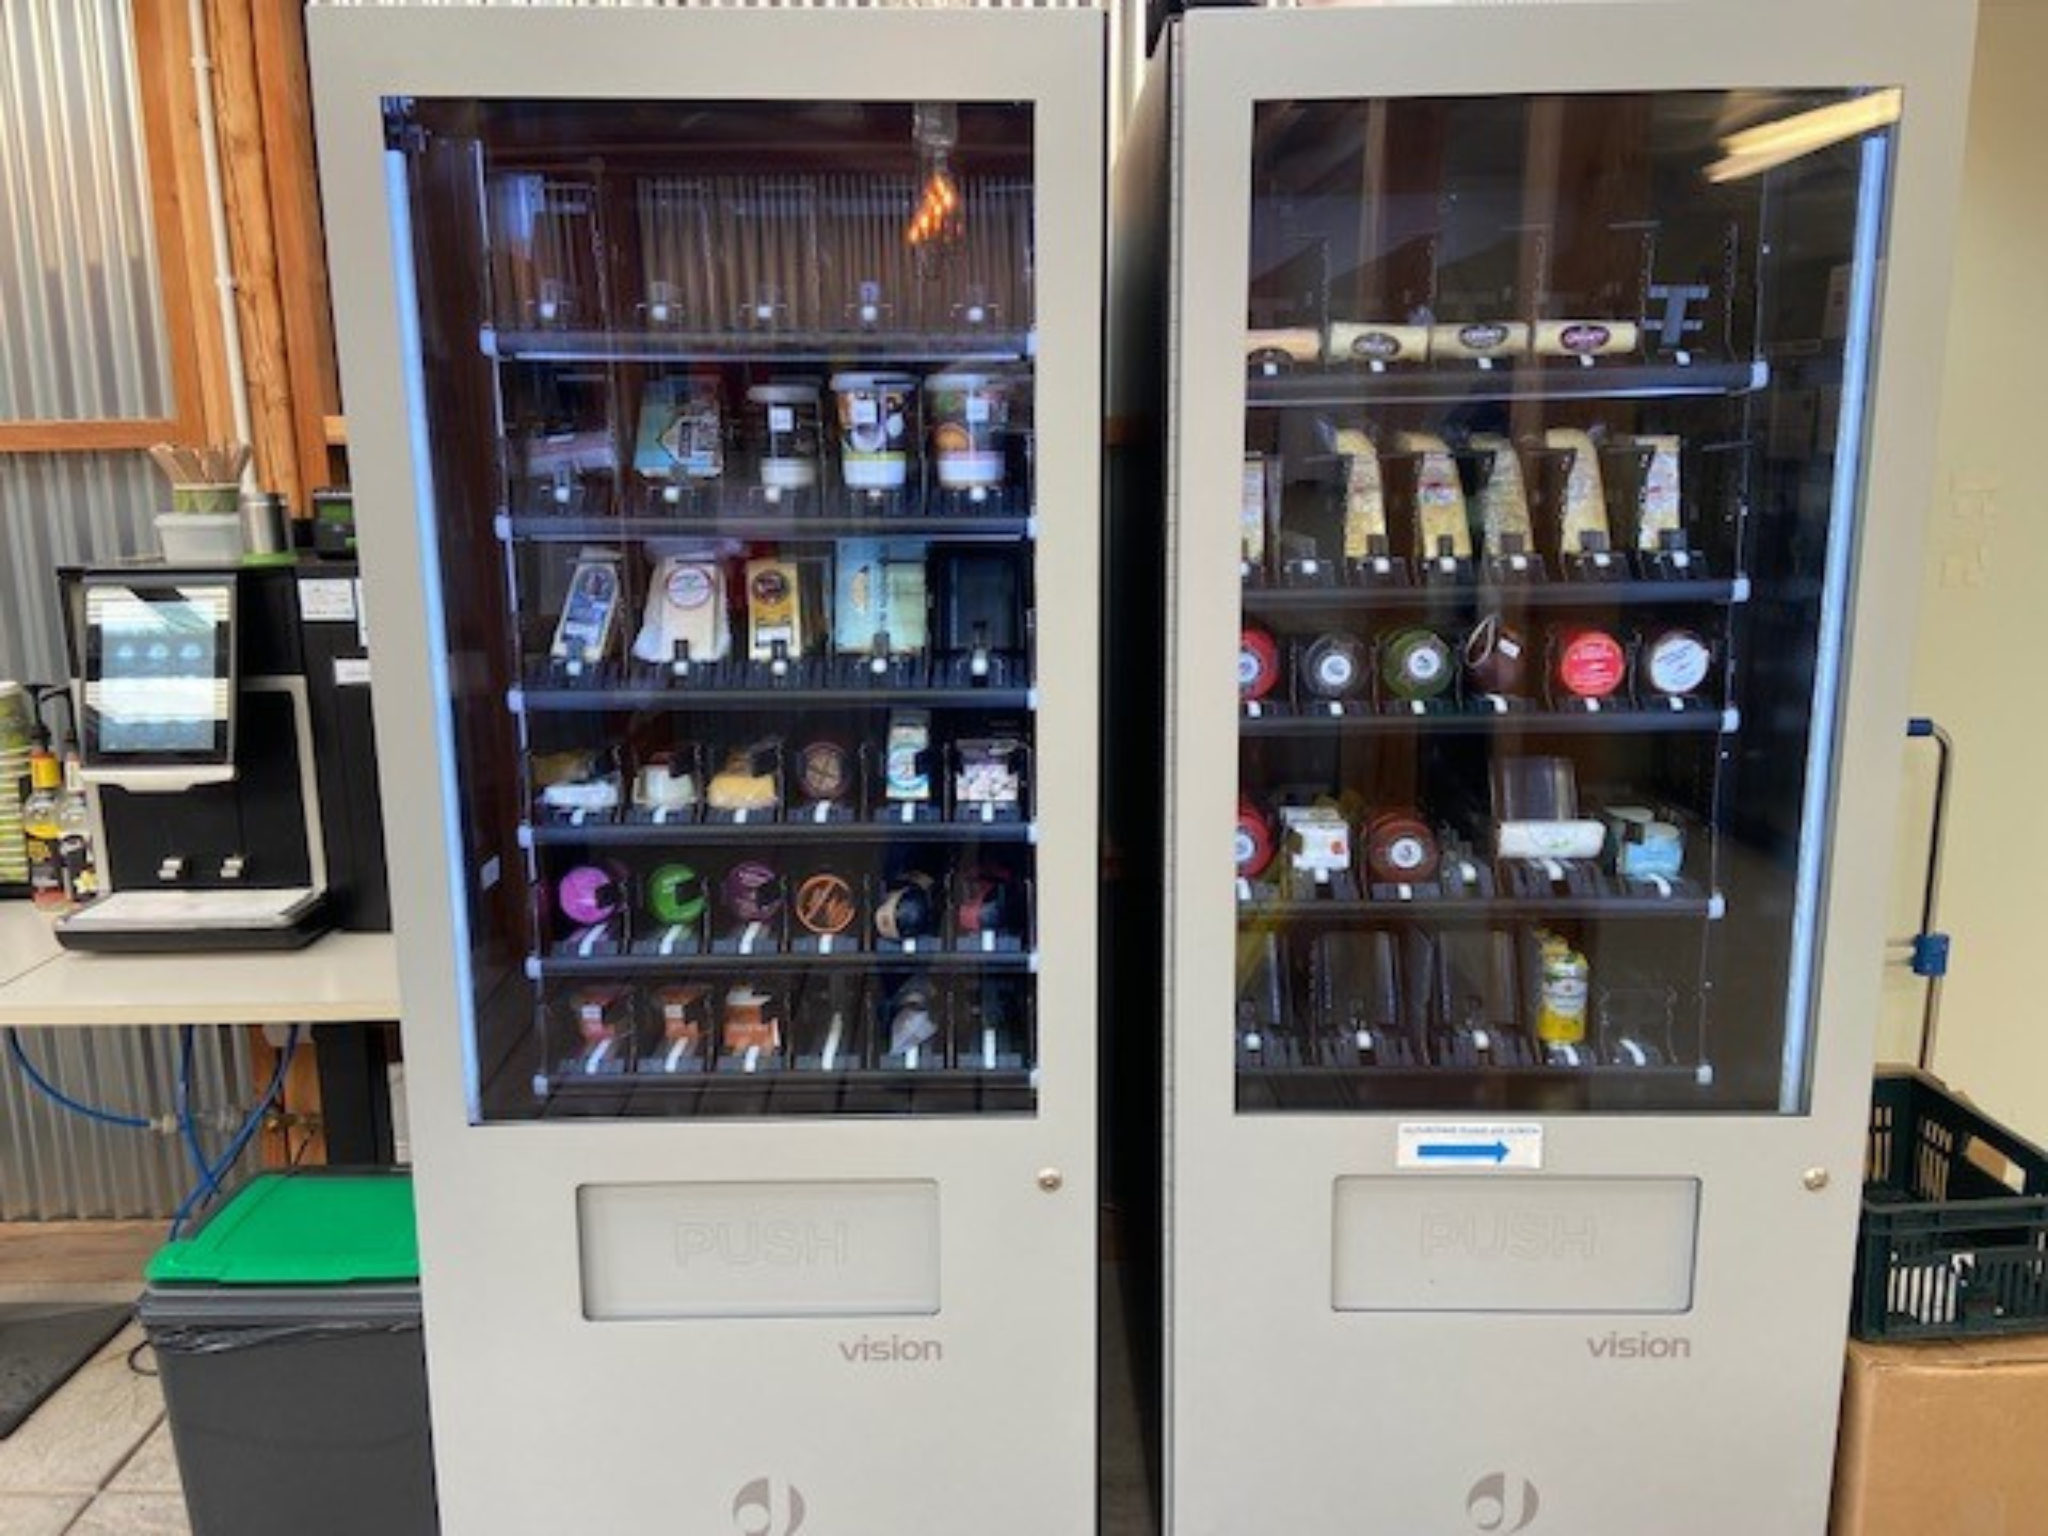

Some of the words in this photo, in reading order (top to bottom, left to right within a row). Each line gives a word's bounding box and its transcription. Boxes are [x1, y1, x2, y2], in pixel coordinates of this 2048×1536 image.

[674, 1220, 849, 1267] PUSH
[1420, 1211, 1598, 1259] PUSH
[839, 1335, 943, 1361] vision
[1587, 1331, 1691, 1358] vision
